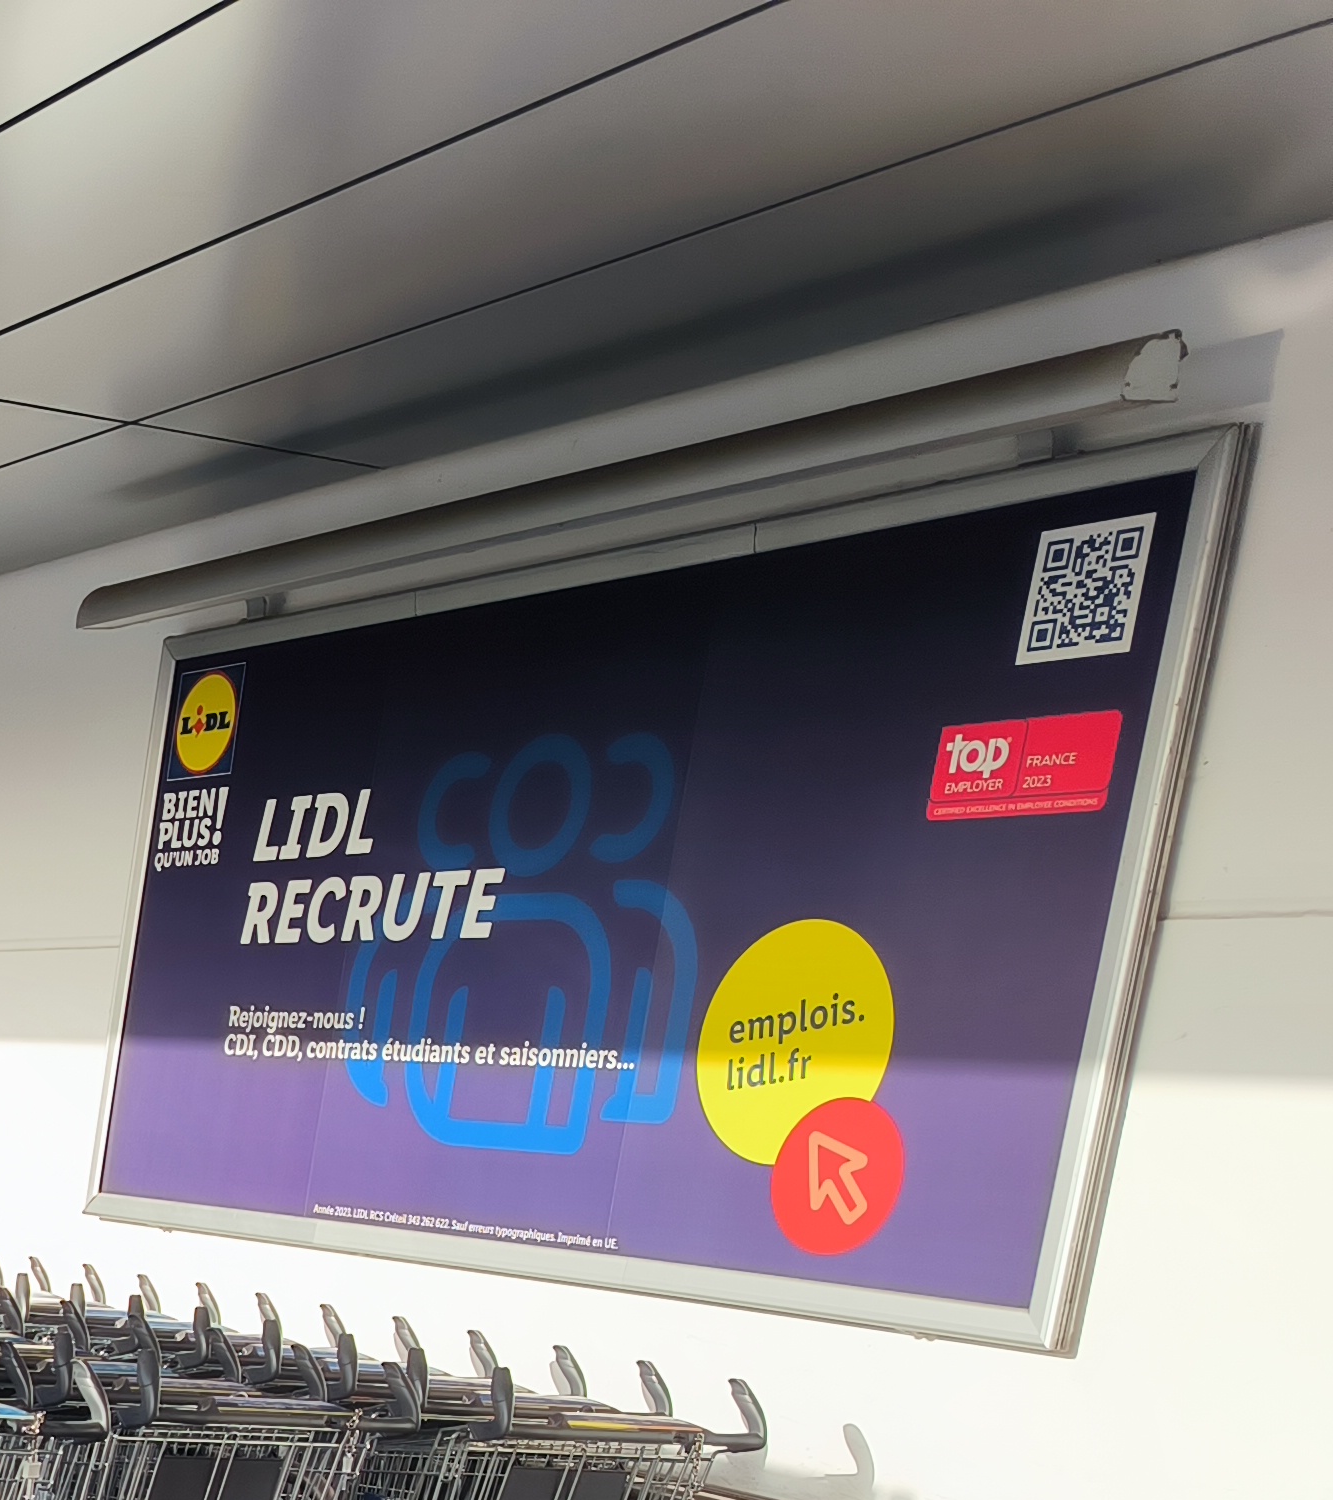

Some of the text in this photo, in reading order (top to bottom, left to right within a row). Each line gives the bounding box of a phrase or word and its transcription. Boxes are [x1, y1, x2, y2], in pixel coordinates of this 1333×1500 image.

[946, 733, 1011, 778] top
[1025, 751, 1078, 768] FRANCE
[944, 778, 1004, 795] EMPLOYER
[1022, 774, 1052, 789] 2023
[162, 788, 216, 821] BIEN
[252, 789, 374, 862] LIDL
[194, 848, 220, 866] JOB
[240, 868, 506, 945] RECRUTE
[228, 1005, 354, 1034] Rejoignez-nous
[729, 992, 866, 1045] emplois.
[224, 1034, 635, 1071] CDI, CDD, contrats étudiants et saisonniers...
[727, 1047, 812, 1091] lidl.fr
[313, 1203, 334, 1216] Année
[353, 1207, 369, 1219] LIDL
[370, 1209, 384, 1221] RCS
[451, 1219, 468, 1231] Sauf
[469, 1223, 495, 1235] erreurs
[556, 1231, 591, 1247] Imprimé
[592, 1239, 603, 1248] en
[604, 1237, 619, 1250] UE.
